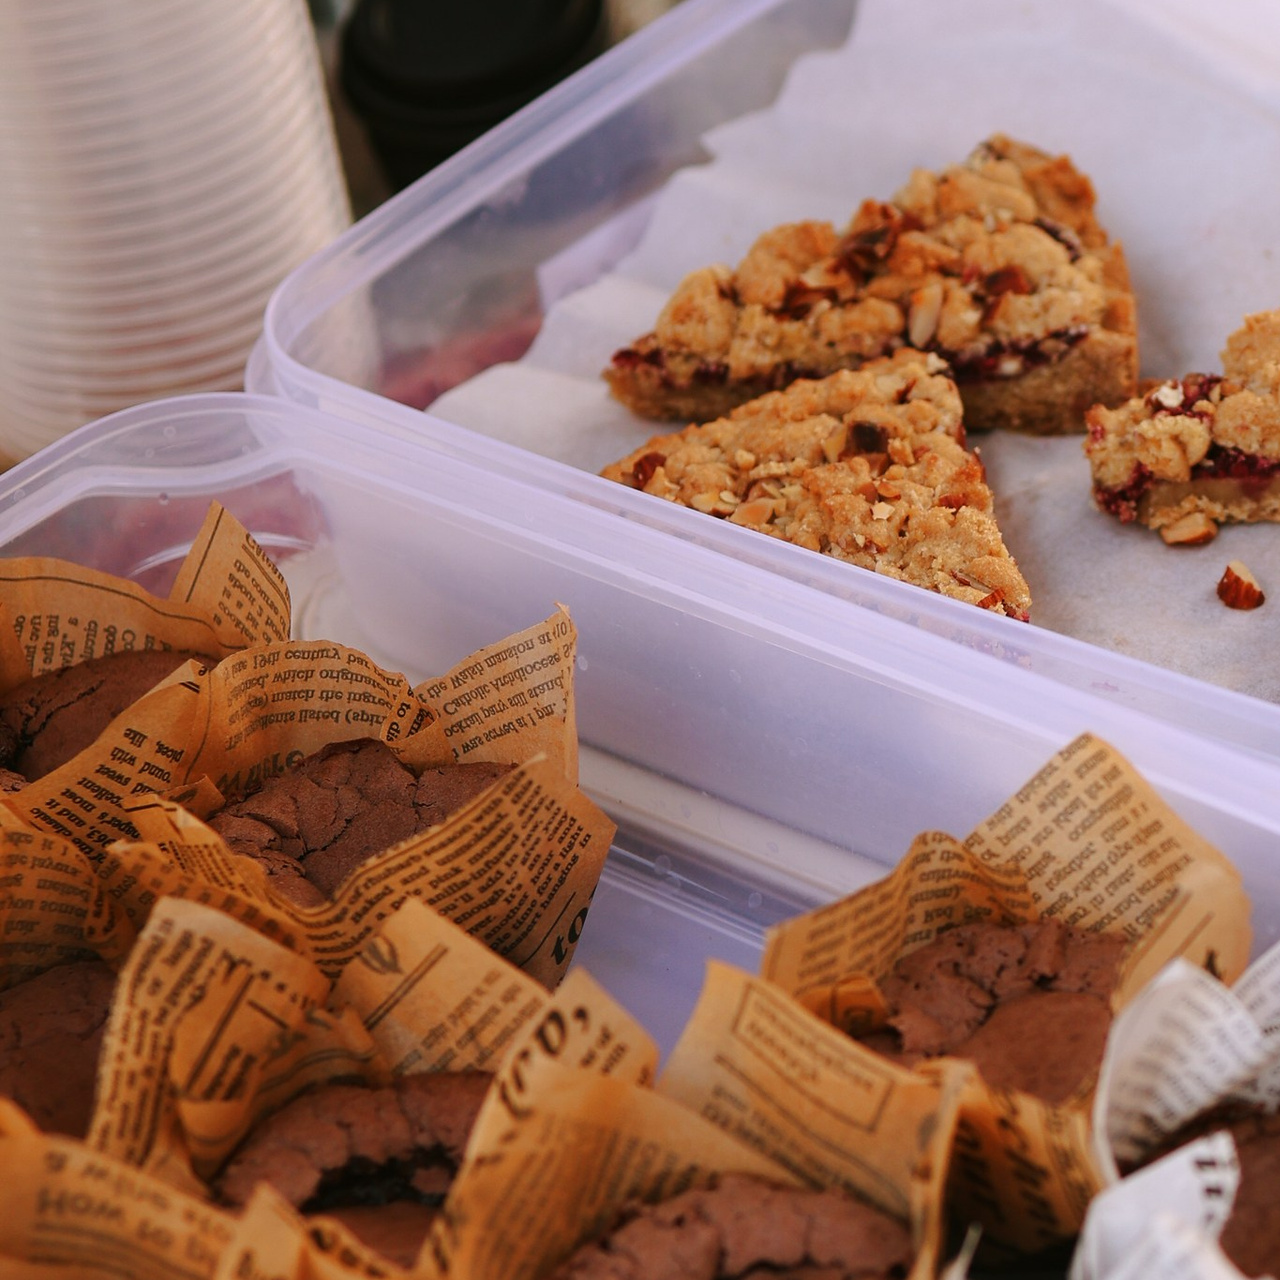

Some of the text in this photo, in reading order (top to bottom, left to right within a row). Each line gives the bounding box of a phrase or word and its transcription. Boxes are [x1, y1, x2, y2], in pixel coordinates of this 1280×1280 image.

[123, 727, 148, 748] like
[109, 747, 137, 765] with
[94, 763, 131, 787] sweet
[59, 788, 96, 812] most
[56, 808, 86, 830] and
[530, 849, 555, 885] hour
[558, 816, 577, 844] and
[537, 874, 554, 896] for
[559, 825, 584, 860] light
[477, 868, 504, 896] add
[541, 853, 580, 910] hanging
[453, 888, 506, 925] enough
